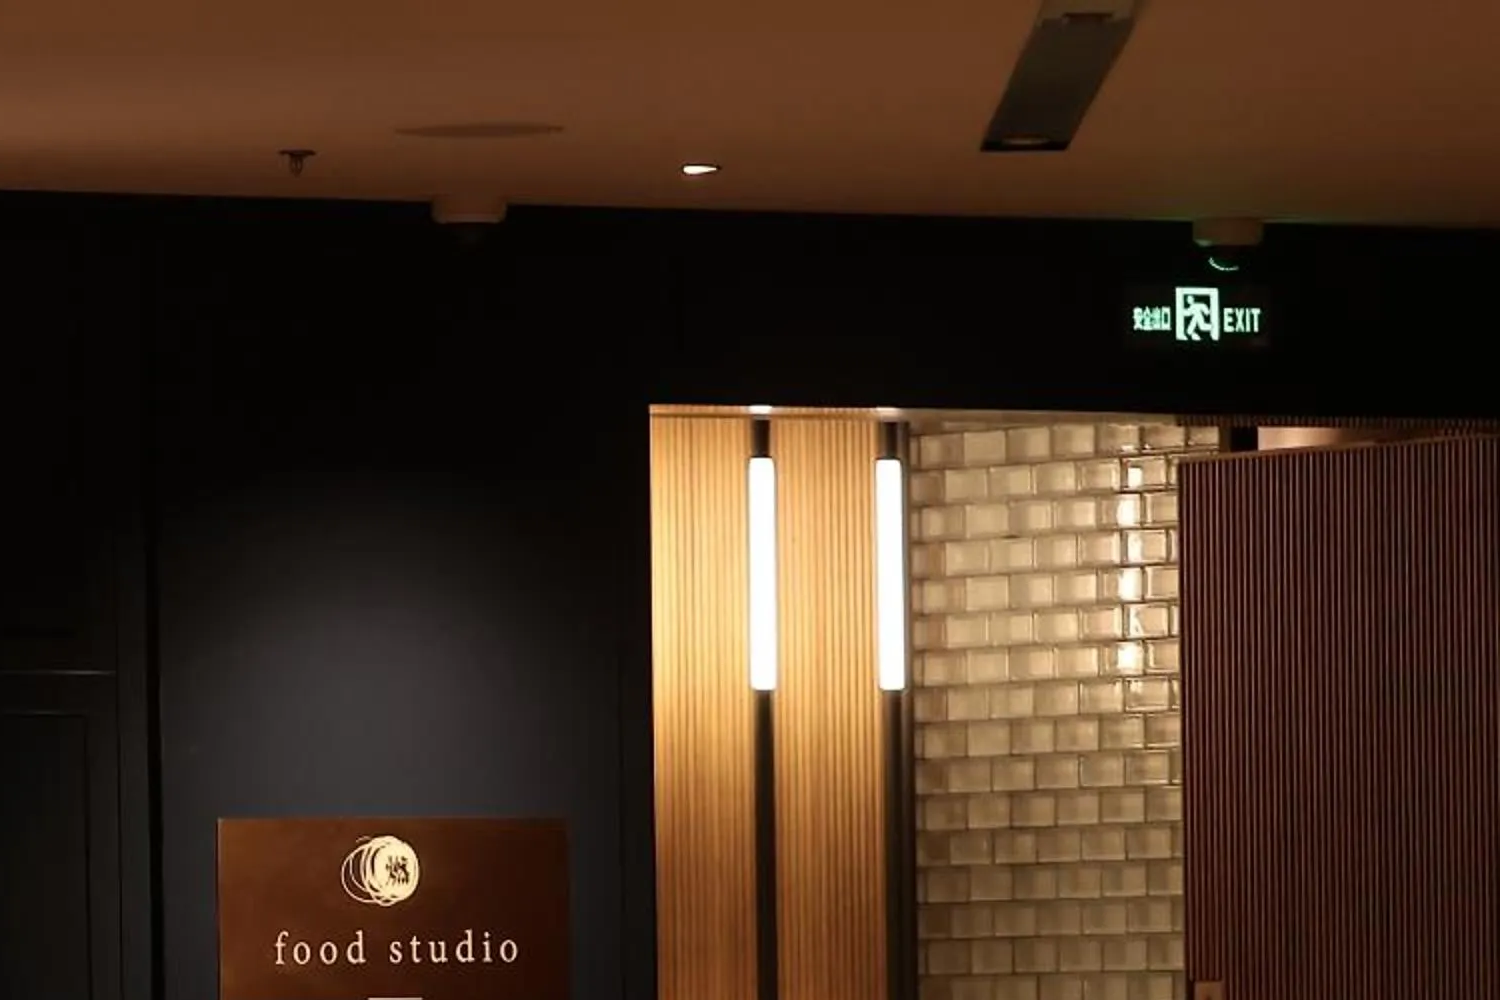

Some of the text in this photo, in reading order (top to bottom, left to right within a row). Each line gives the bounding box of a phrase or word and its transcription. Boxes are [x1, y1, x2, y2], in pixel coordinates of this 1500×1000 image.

[1223, 307, 1261, 333] EXIT
[274, 928, 519, 965] food studio
